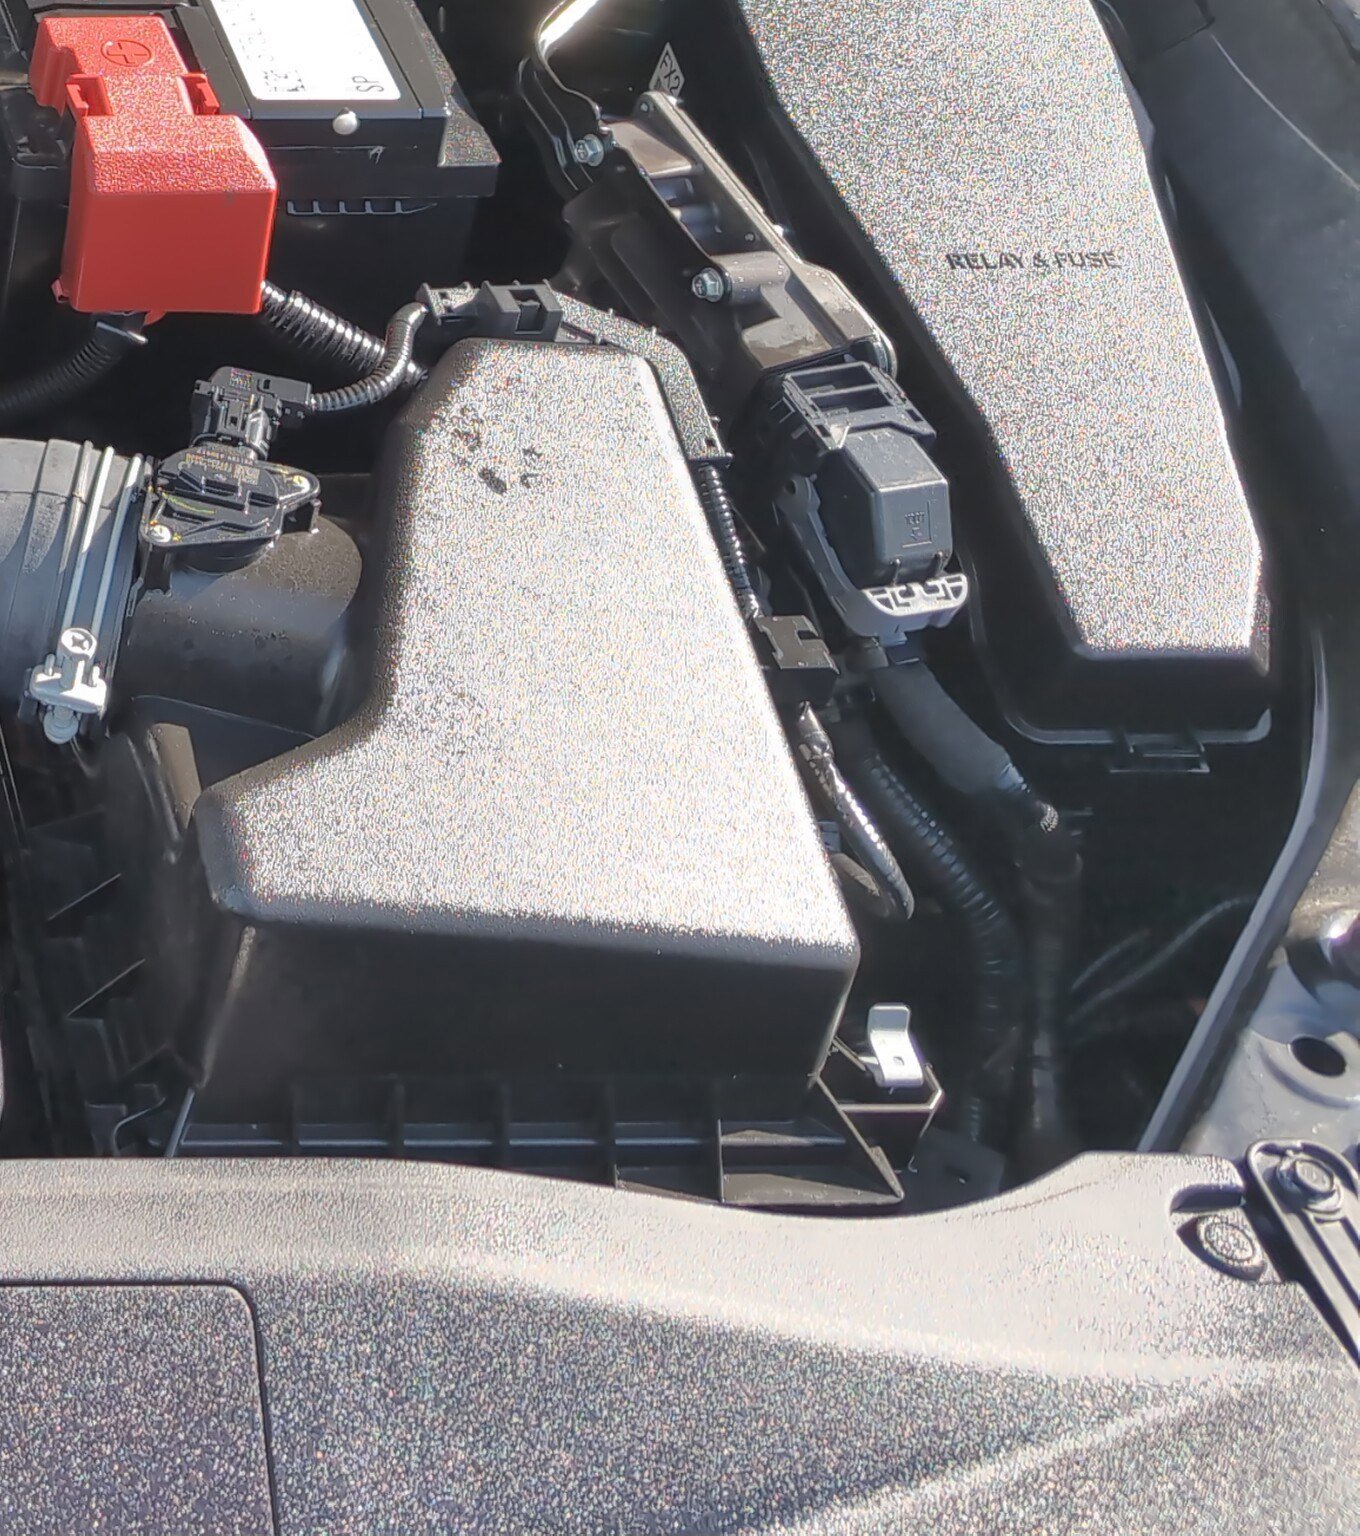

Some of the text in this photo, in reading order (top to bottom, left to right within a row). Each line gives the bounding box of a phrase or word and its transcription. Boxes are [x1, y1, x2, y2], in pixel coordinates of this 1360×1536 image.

[352, 75, 385, 92] SP
[945, 251, 1122, 270] RELAY & FUSE
